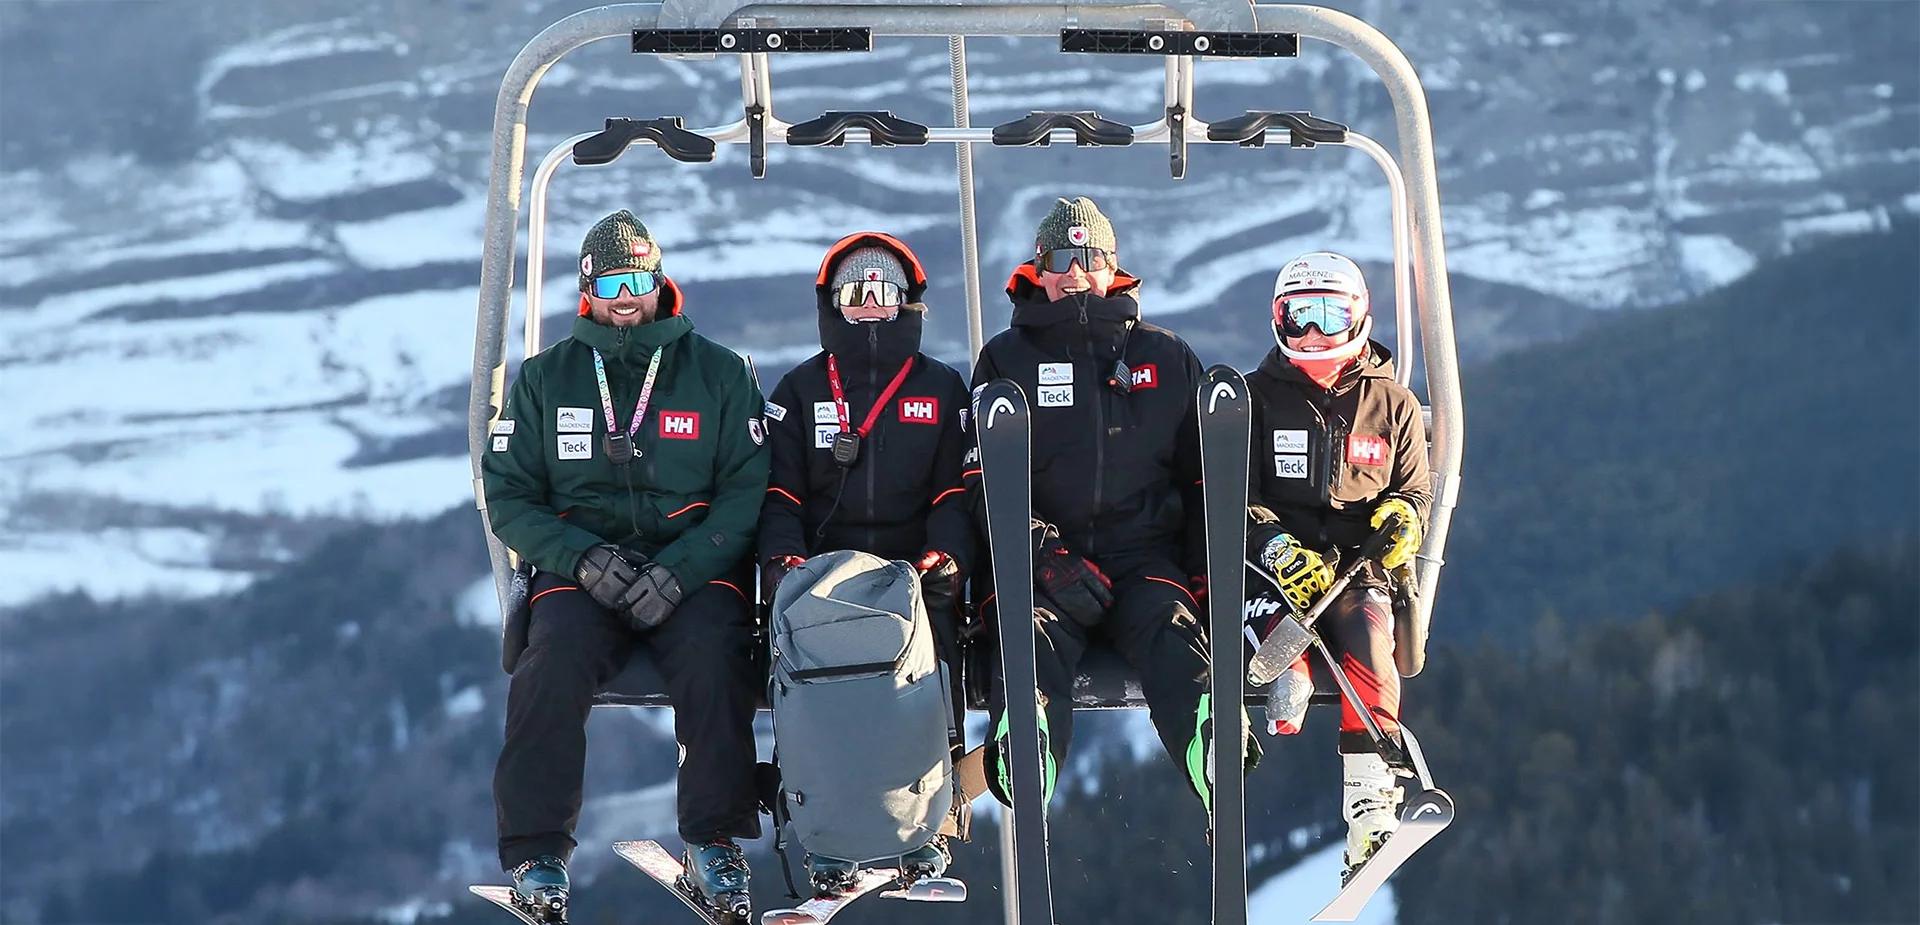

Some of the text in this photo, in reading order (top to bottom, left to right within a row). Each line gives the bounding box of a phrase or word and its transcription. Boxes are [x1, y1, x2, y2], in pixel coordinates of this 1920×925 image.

[1041, 390, 1070, 403] Teck
[904, 402, 932, 419] HH
[665, 416, 693, 434] HH
[818, 430, 833, 443] Te
[562, 441, 587, 452] Teck
[1352, 440, 1381, 460] HH
[1278, 460, 1304, 474] Teck
[1286, 560, 1303, 573] LEVEL
